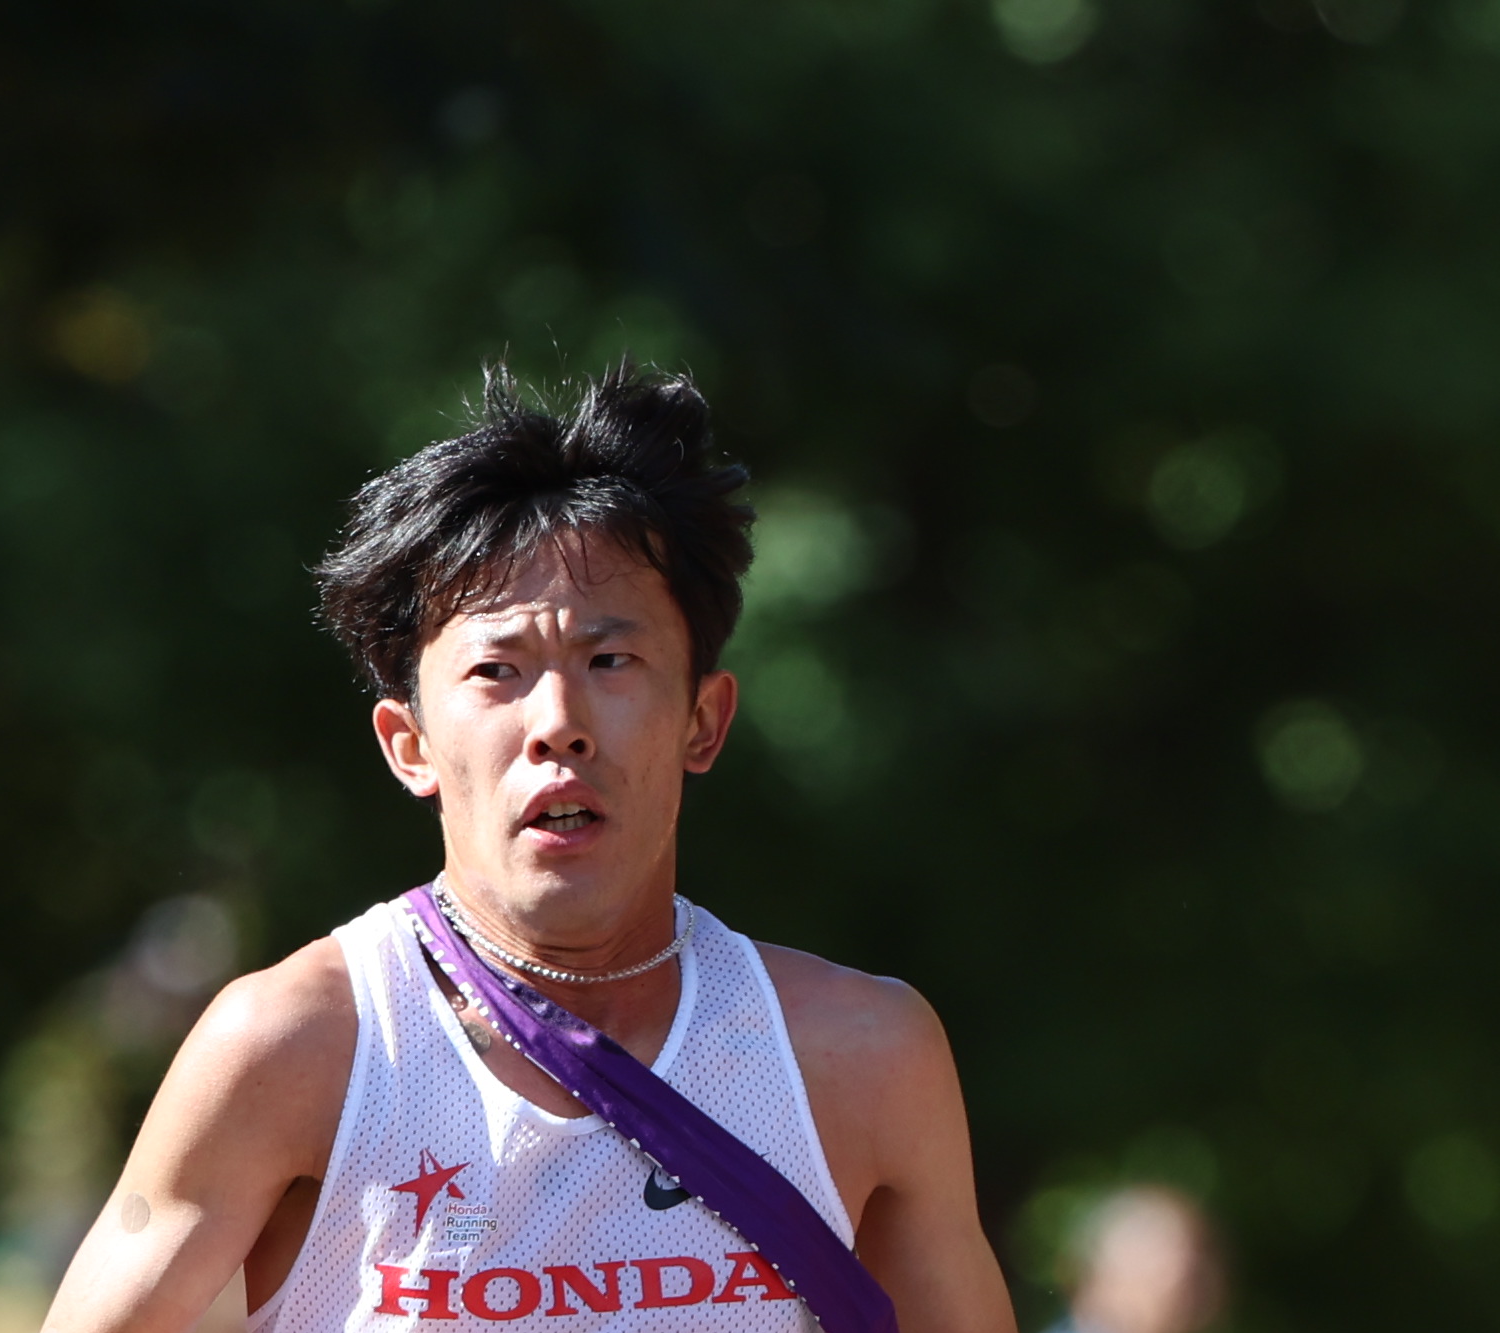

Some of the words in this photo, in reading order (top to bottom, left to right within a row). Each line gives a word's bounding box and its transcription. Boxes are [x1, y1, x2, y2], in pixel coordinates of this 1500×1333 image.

[448, 1203, 487, 1214] Honda
[446, 1217, 498, 1230] Running
[446, 1231, 480, 1241] Team
[374, 1251, 799, 1321] HONDA
